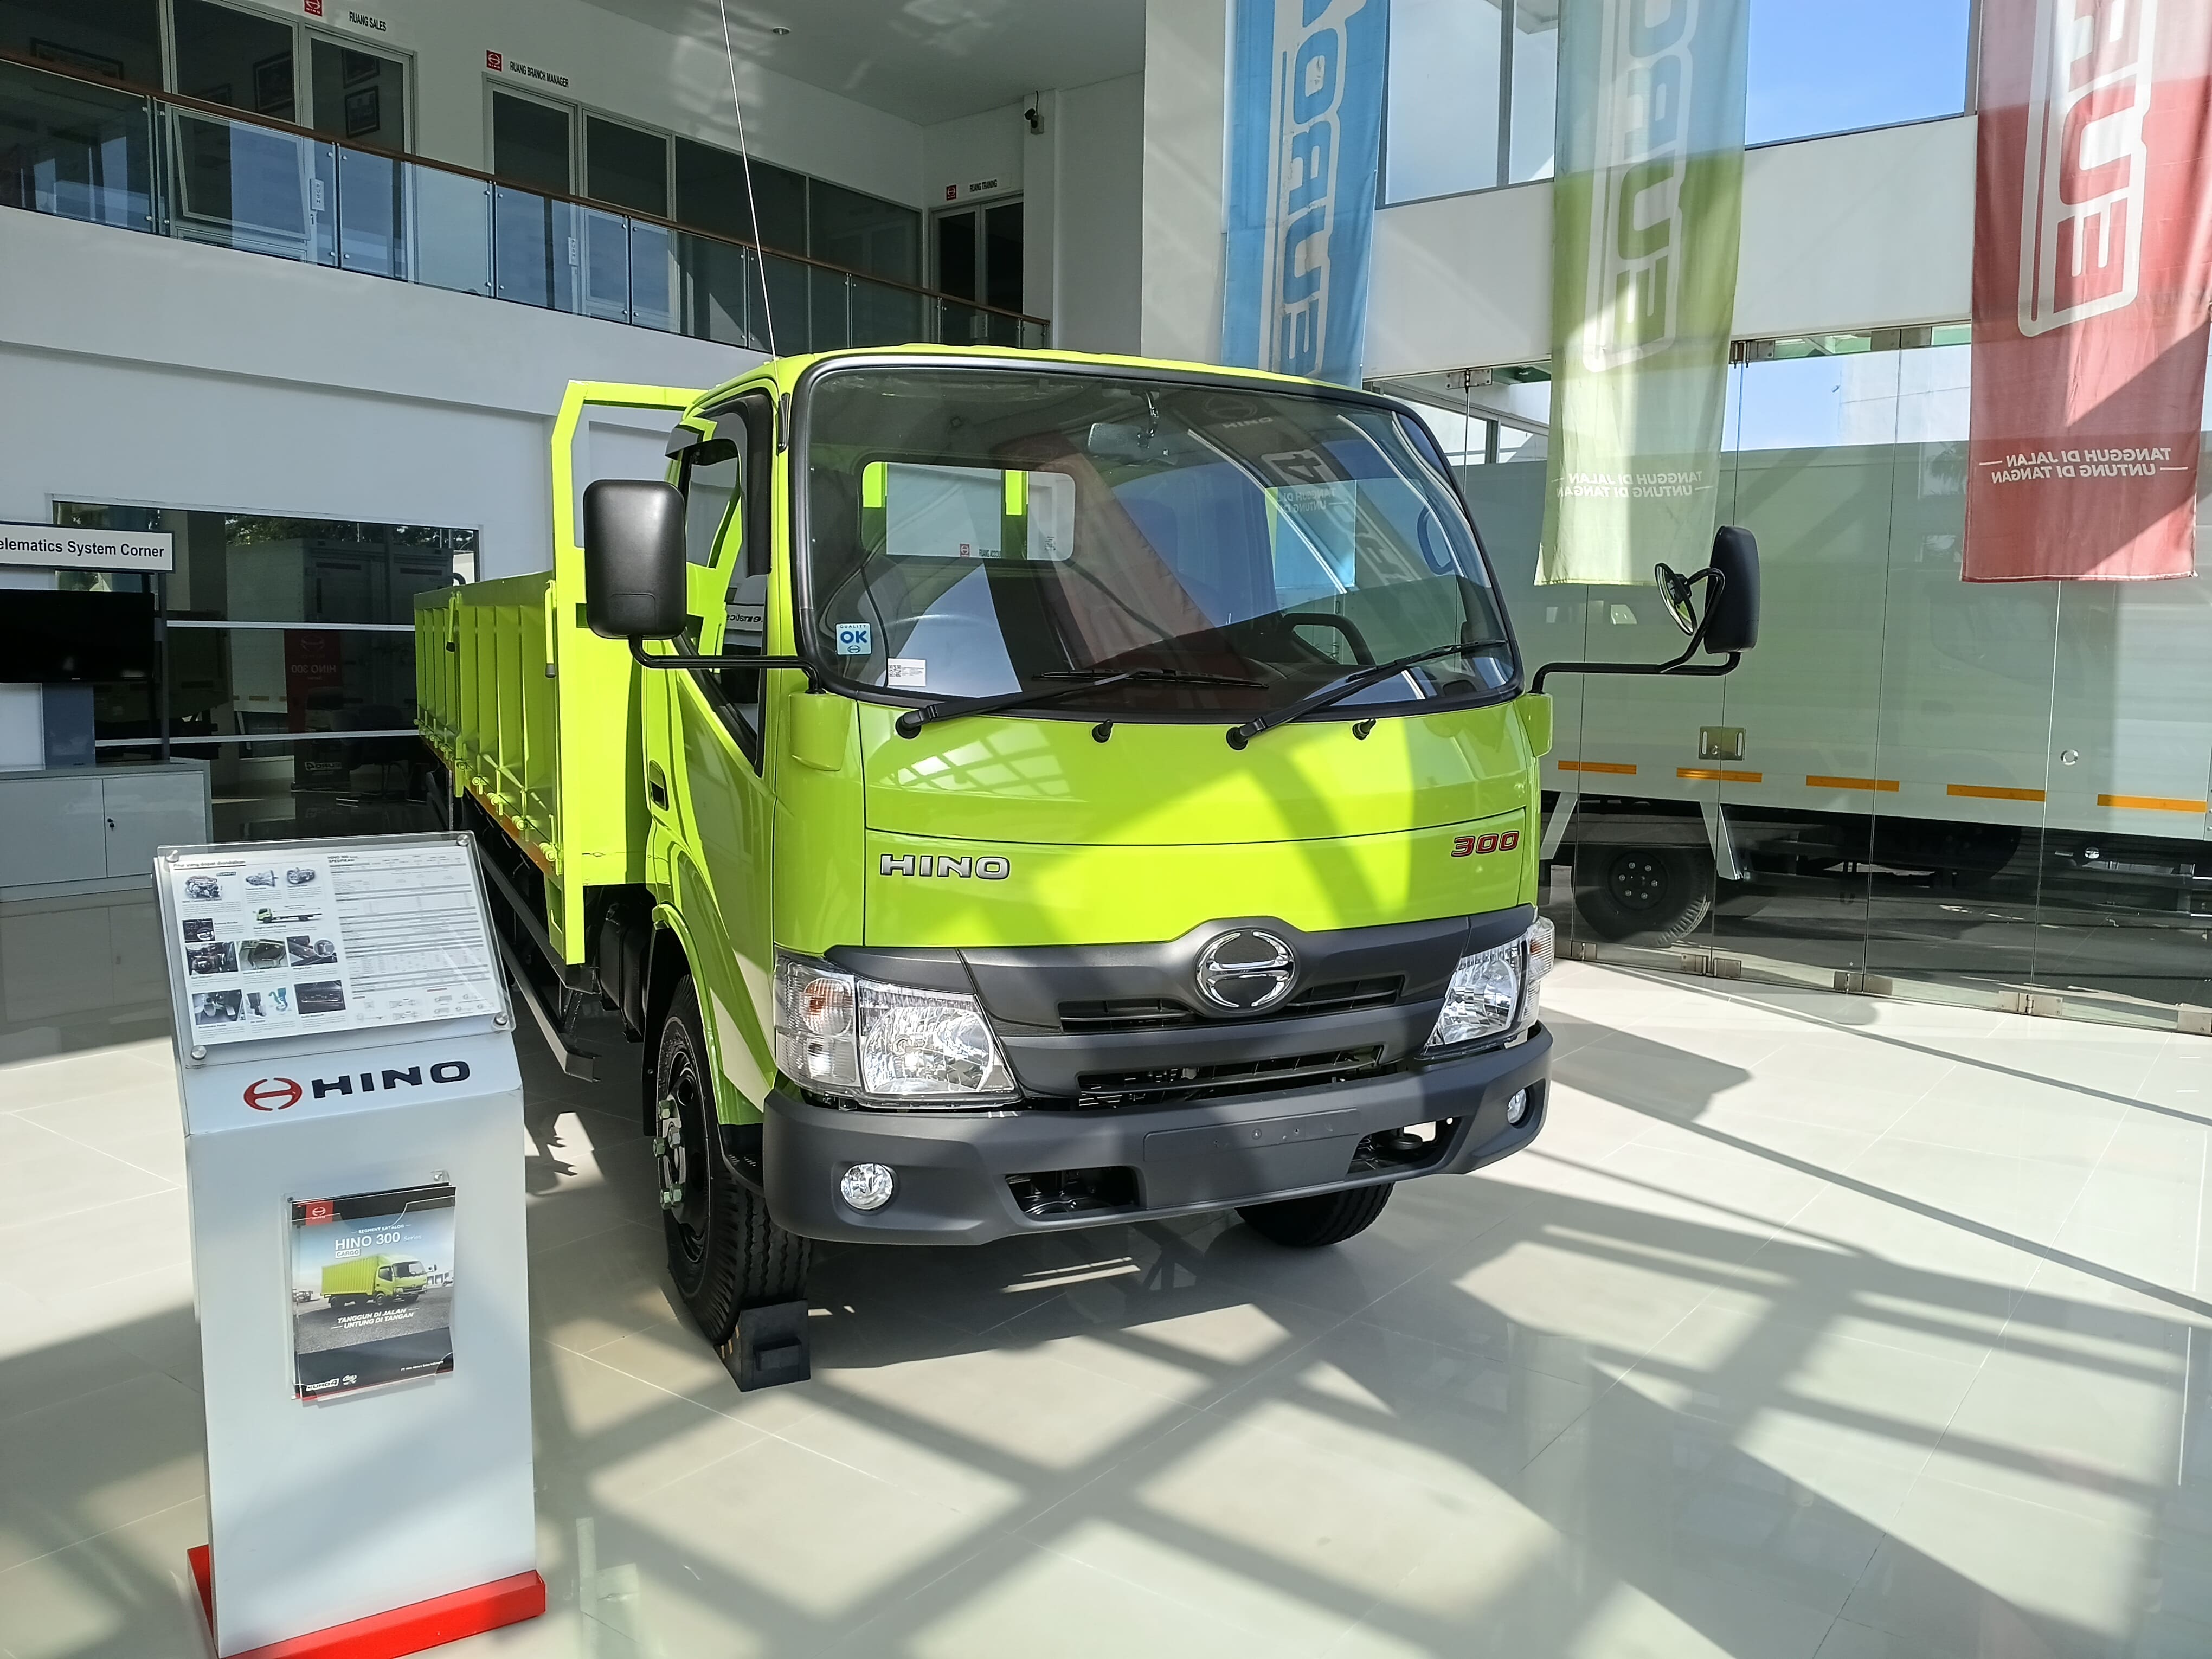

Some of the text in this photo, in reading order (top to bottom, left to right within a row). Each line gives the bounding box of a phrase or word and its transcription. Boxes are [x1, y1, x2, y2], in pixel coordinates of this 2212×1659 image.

[349, 11, 387, 32] RUANG SALES
[510, 61, 569, 88] RUANG BRANCH MANAGER
[67, 541, 116, 557] System
[120, 543, 164, 557] Corner
[840, 630, 867, 644] OK
[1451, 830, 1520, 858] 300
[880, 853, 1010, 880] HINO
[311, 1060, 471, 1099] HINO
[335, 1232, 422, 1251] HINO 300 Series
[337, 1312, 373, 1324] TANGGUH
[382, 1308, 407, 1316] JALAN
[343, 1318, 374, 1329] UNTUNG
[384, 1311, 415, 1322] TANGAN
